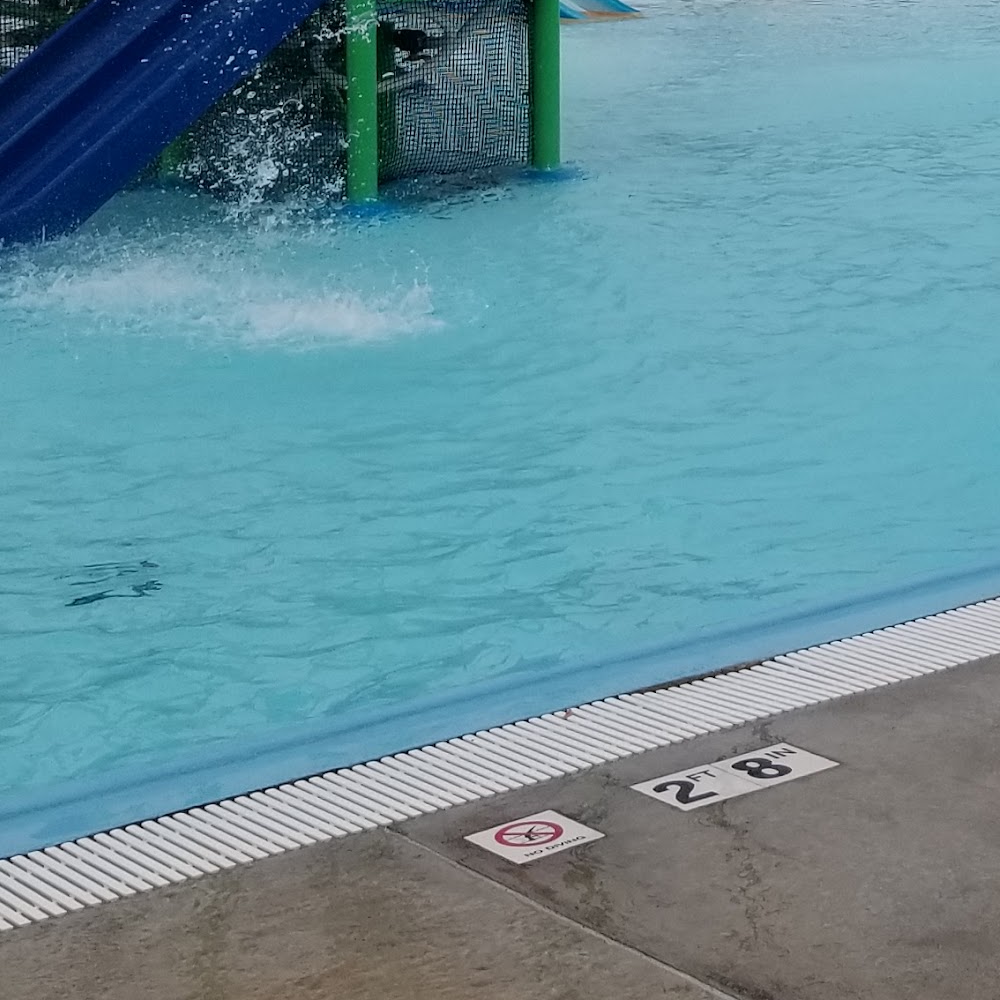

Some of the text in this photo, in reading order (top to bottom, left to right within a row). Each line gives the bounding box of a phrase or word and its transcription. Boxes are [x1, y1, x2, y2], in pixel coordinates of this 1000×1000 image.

[652, 747, 798, 805] 2 FT 8 IN
[523, 835, 587, 858] NO DIVING
